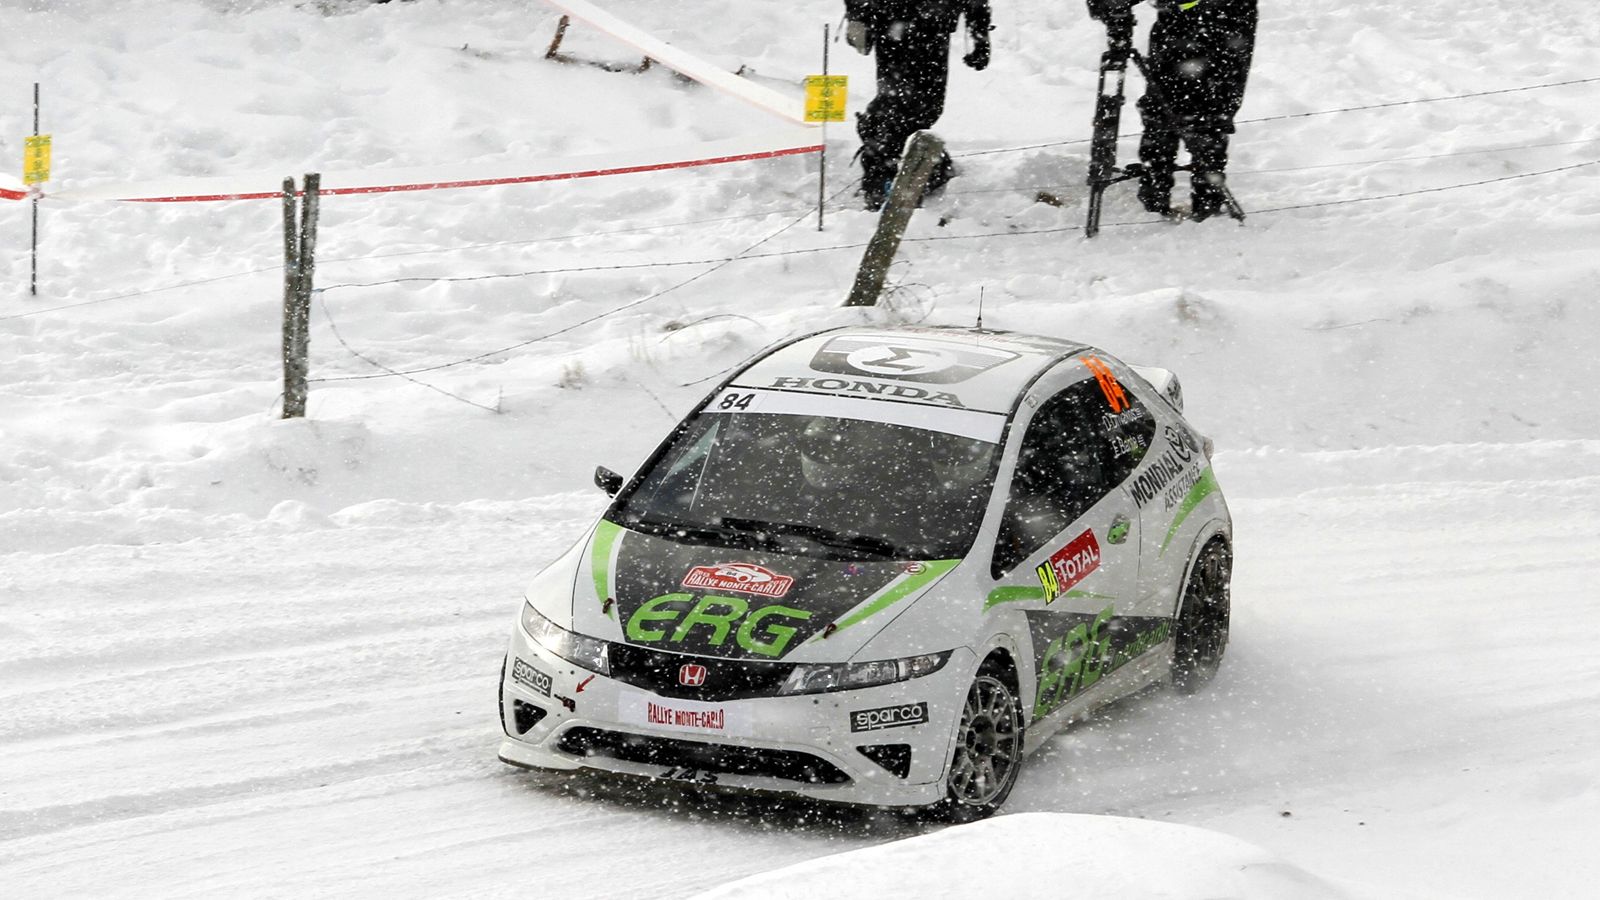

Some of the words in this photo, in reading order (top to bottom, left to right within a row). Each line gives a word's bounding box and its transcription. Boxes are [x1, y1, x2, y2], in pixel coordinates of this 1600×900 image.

[719, 393, 757, 411] 84
[768, 376, 965, 407] HONDA
[1130, 449, 1184, 509] MONDIAL
[1164, 462, 1202, 512] ASSISTANCE
[1055, 545, 1098, 583] TOTAL
[687, 574, 717, 586] RALLYE
[719, 580, 785, 595] MONTE-CARLO
[1038, 562, 1058, 603] 84
[626, 593, 812, 657] ERG
[514, 661, 549, 690] sparco
[647, 701, 673, 725] RALLYE
[675, 708, 725, 730] MONTE-CARLO
[856, 705, 923, 730] sparco
